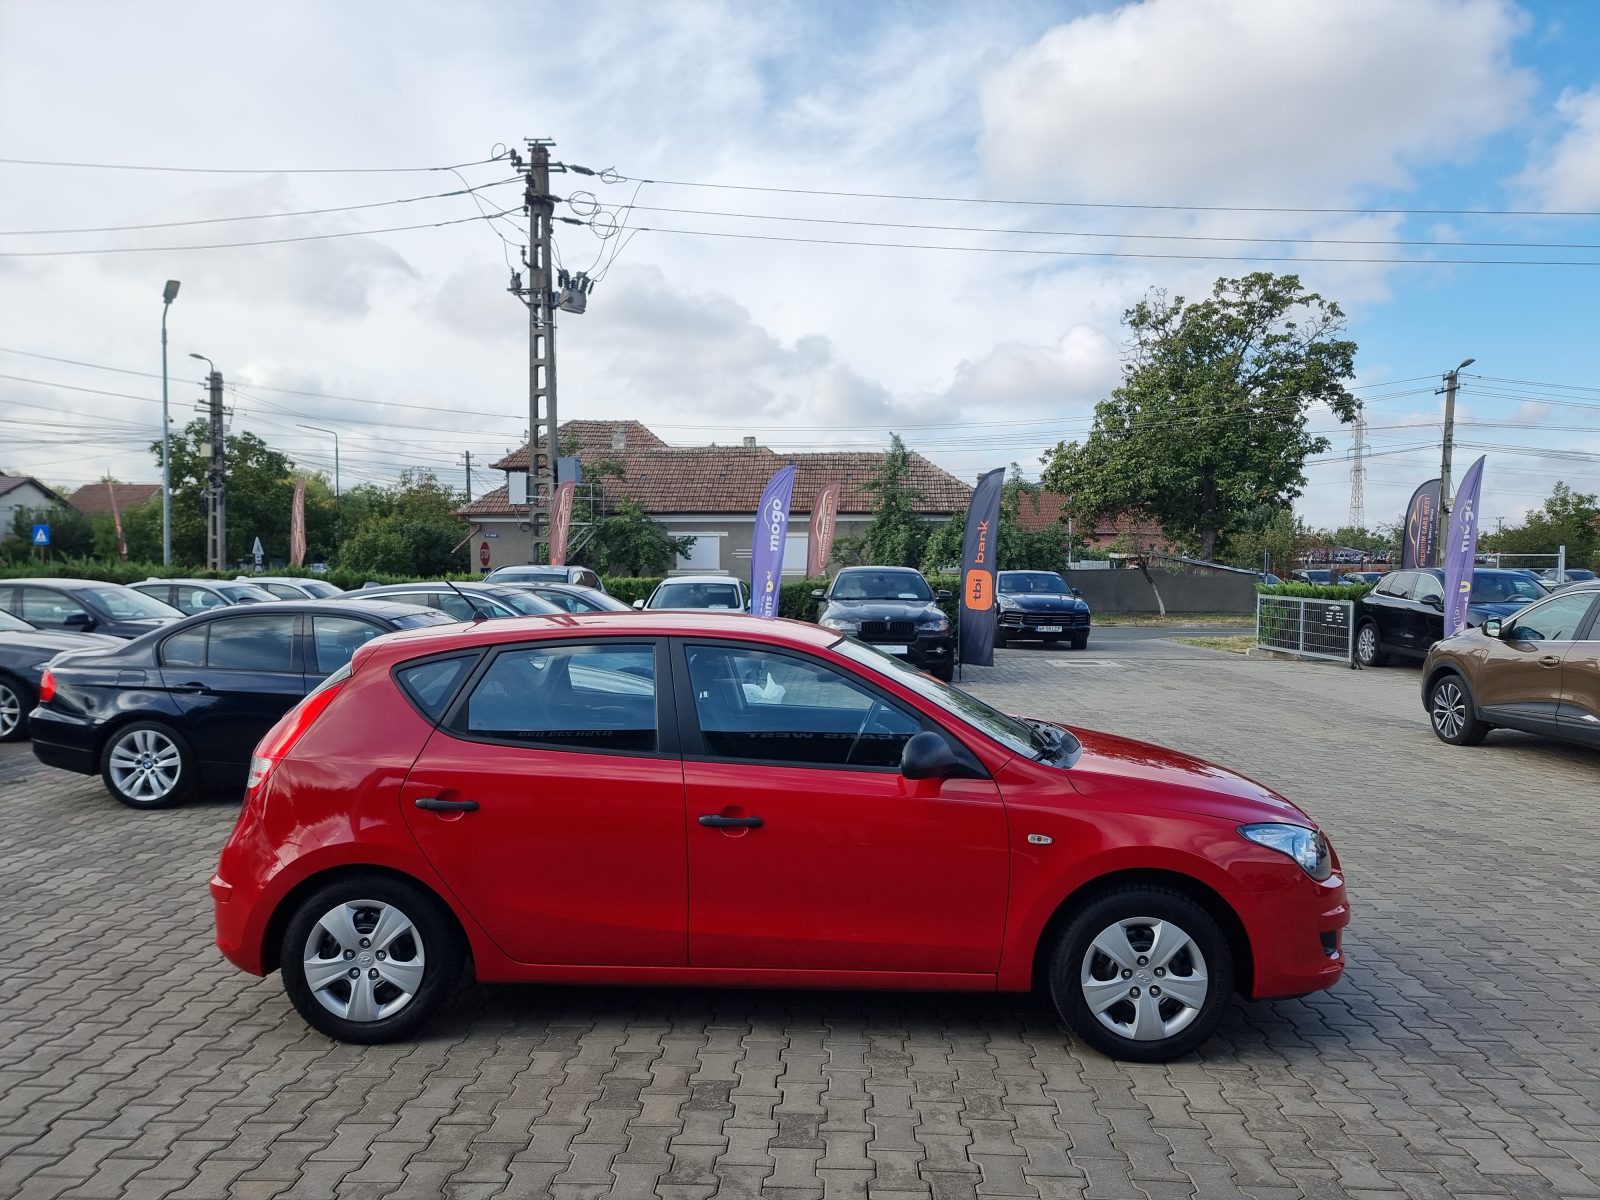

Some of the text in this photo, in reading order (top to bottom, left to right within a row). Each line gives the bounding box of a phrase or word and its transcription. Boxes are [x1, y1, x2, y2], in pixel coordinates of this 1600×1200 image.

[769, 498, 785, 552] mogo
[1419, 496, 1431, 567] PREMIUM CARS WEST
[972, 520, 989, 602] tbi bank
